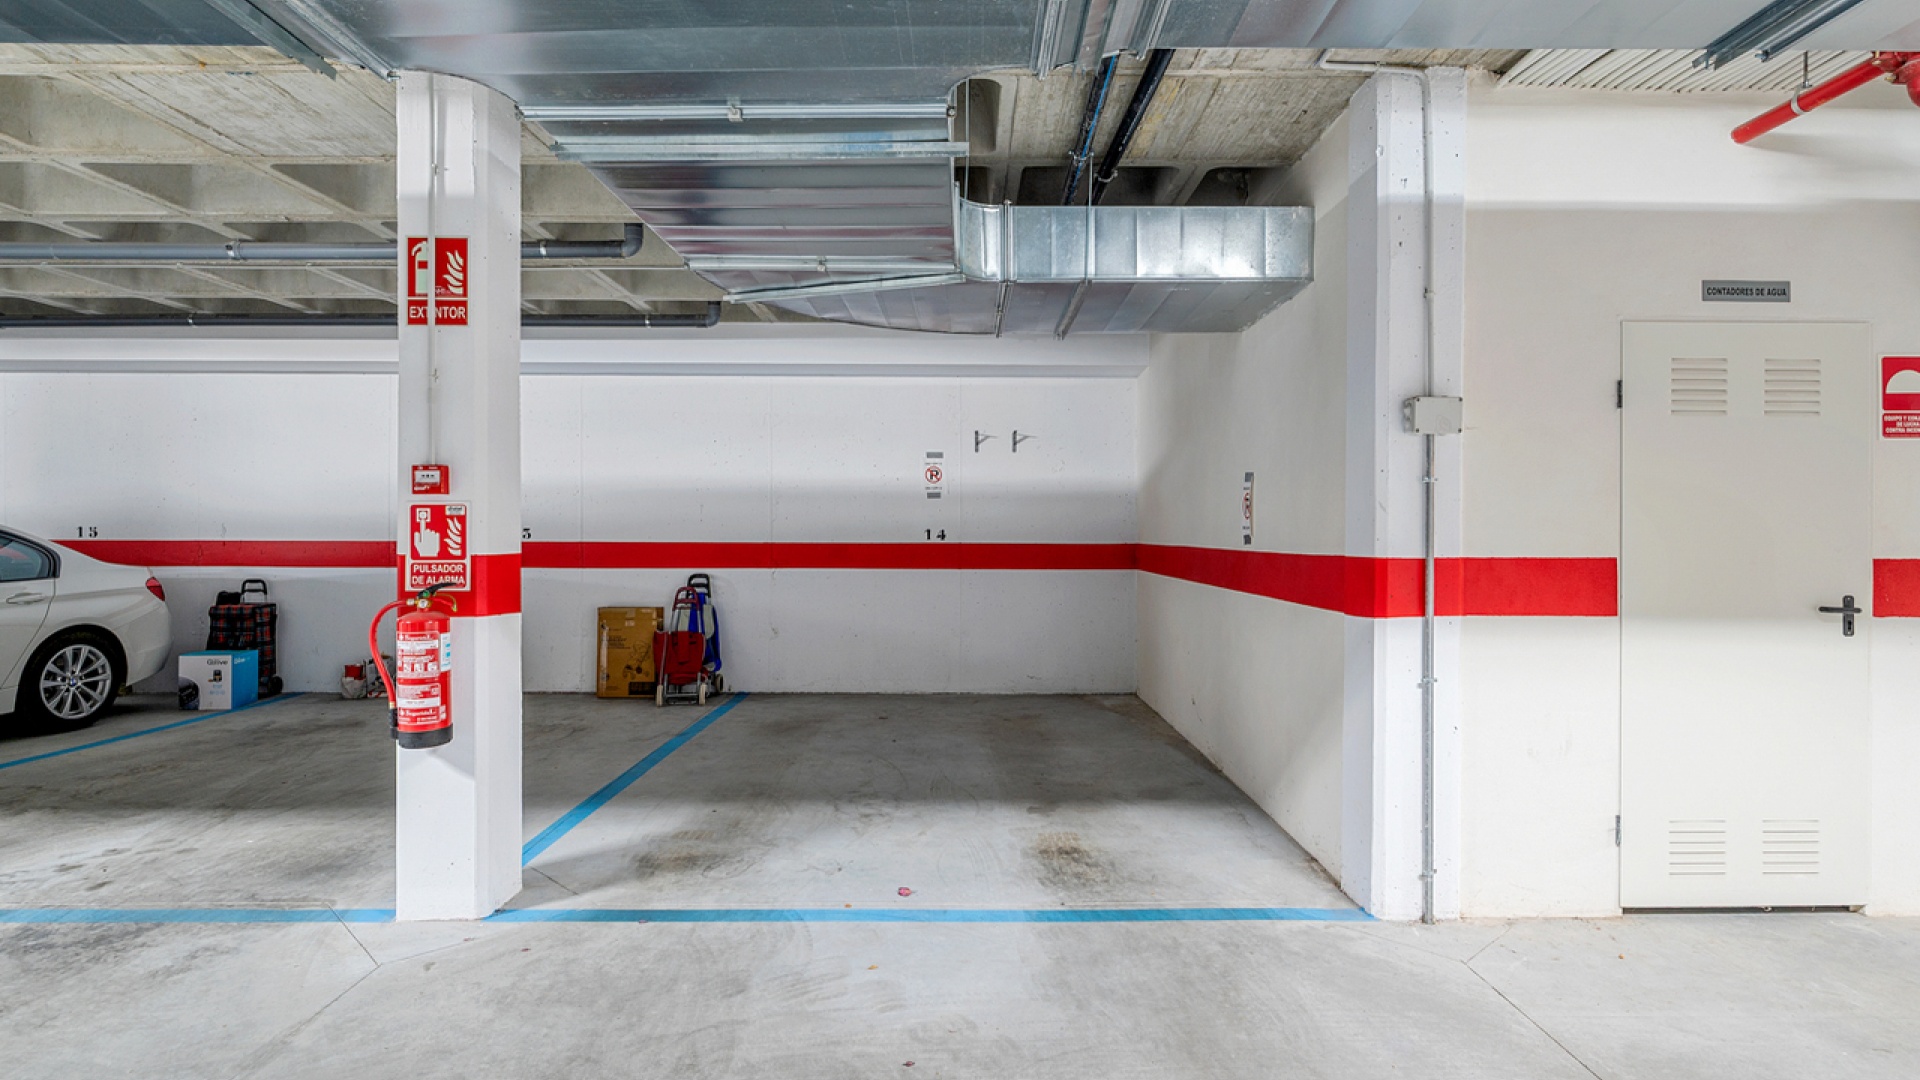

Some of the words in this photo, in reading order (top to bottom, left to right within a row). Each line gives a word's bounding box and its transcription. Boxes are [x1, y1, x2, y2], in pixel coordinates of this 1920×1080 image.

[1706, 286, 1754, 296] CONTADORES
[1755, 287, 1765, 296] DE
[1766, 287, 1787, 296] AGUA
[409, 306, 466, 319] EXTNTOR
[77, 526, 98, 538] 15
[924, 528, 946, 541] 14
[413, 564, 464, 573] PULSADOR
[411, 575, 425, 585] DE
[426, 575, 466, 585] ALARMA
